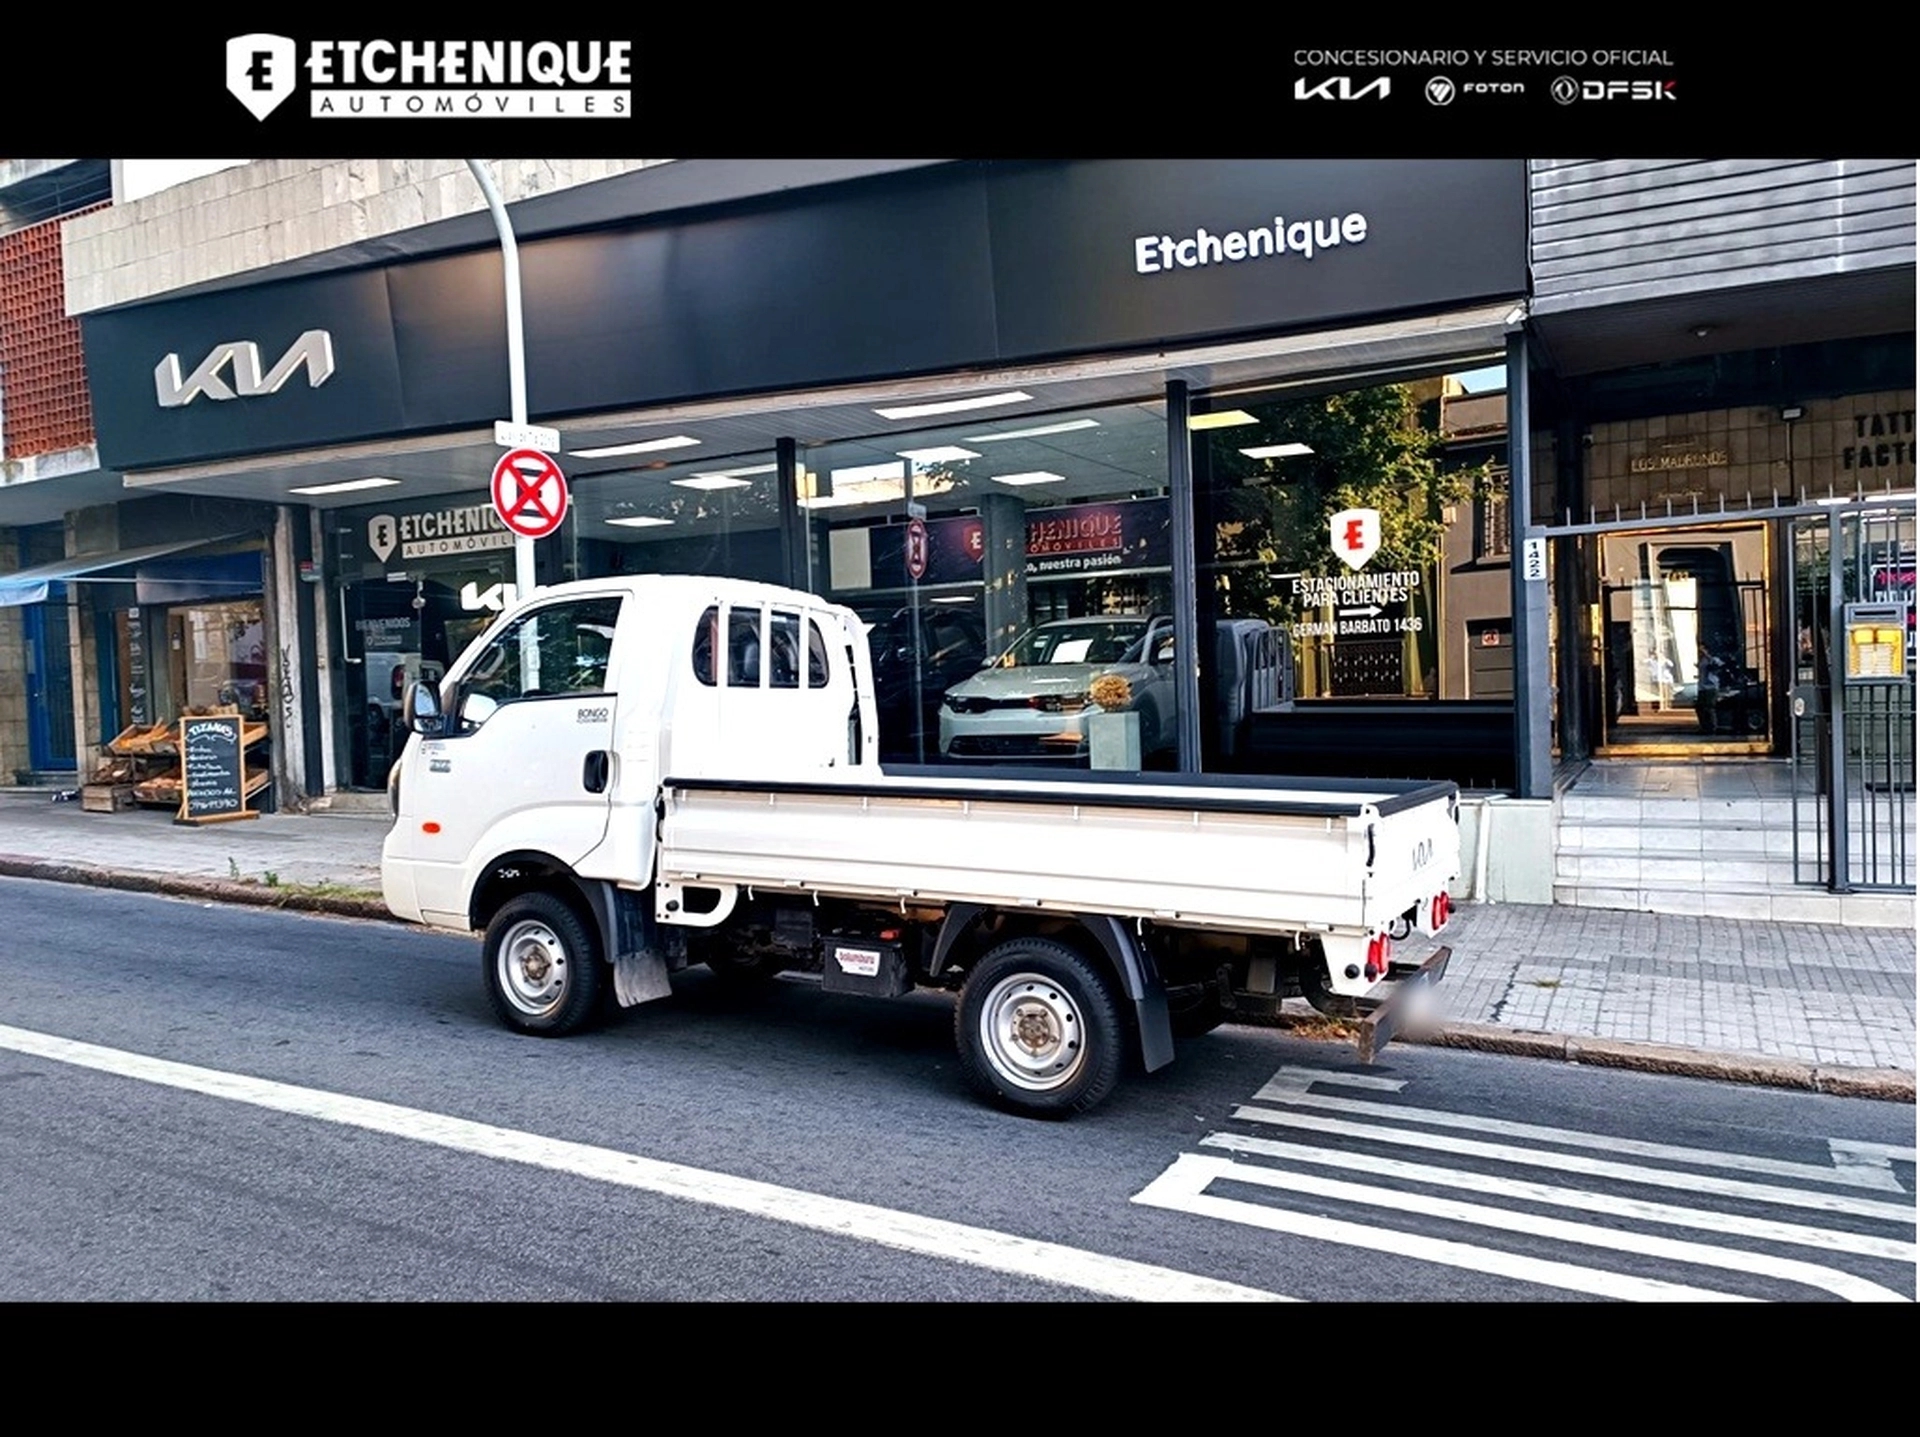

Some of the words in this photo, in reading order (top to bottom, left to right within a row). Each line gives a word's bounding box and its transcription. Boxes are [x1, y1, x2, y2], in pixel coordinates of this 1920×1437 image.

[1135, 213, 1367, 273] Etchenique
[155, 329, 335, 407] KIA
[1039, 557, 1081, 570] nuestra
[1083, 553, 1122, 569] pasión
[1529, 541, 1540, 577] 1422
[1292, 571, 1420, 594] ESTACIONAMIENTO
[1303, 592, 1339, 607] PARA
[1342, 587, 1408, 605] CLIENTES
[1340, 618, 1391, 635] BARBATO
[1394, 616, 1423, 632] 1436
[577, 707, 609, 719] BONGO
